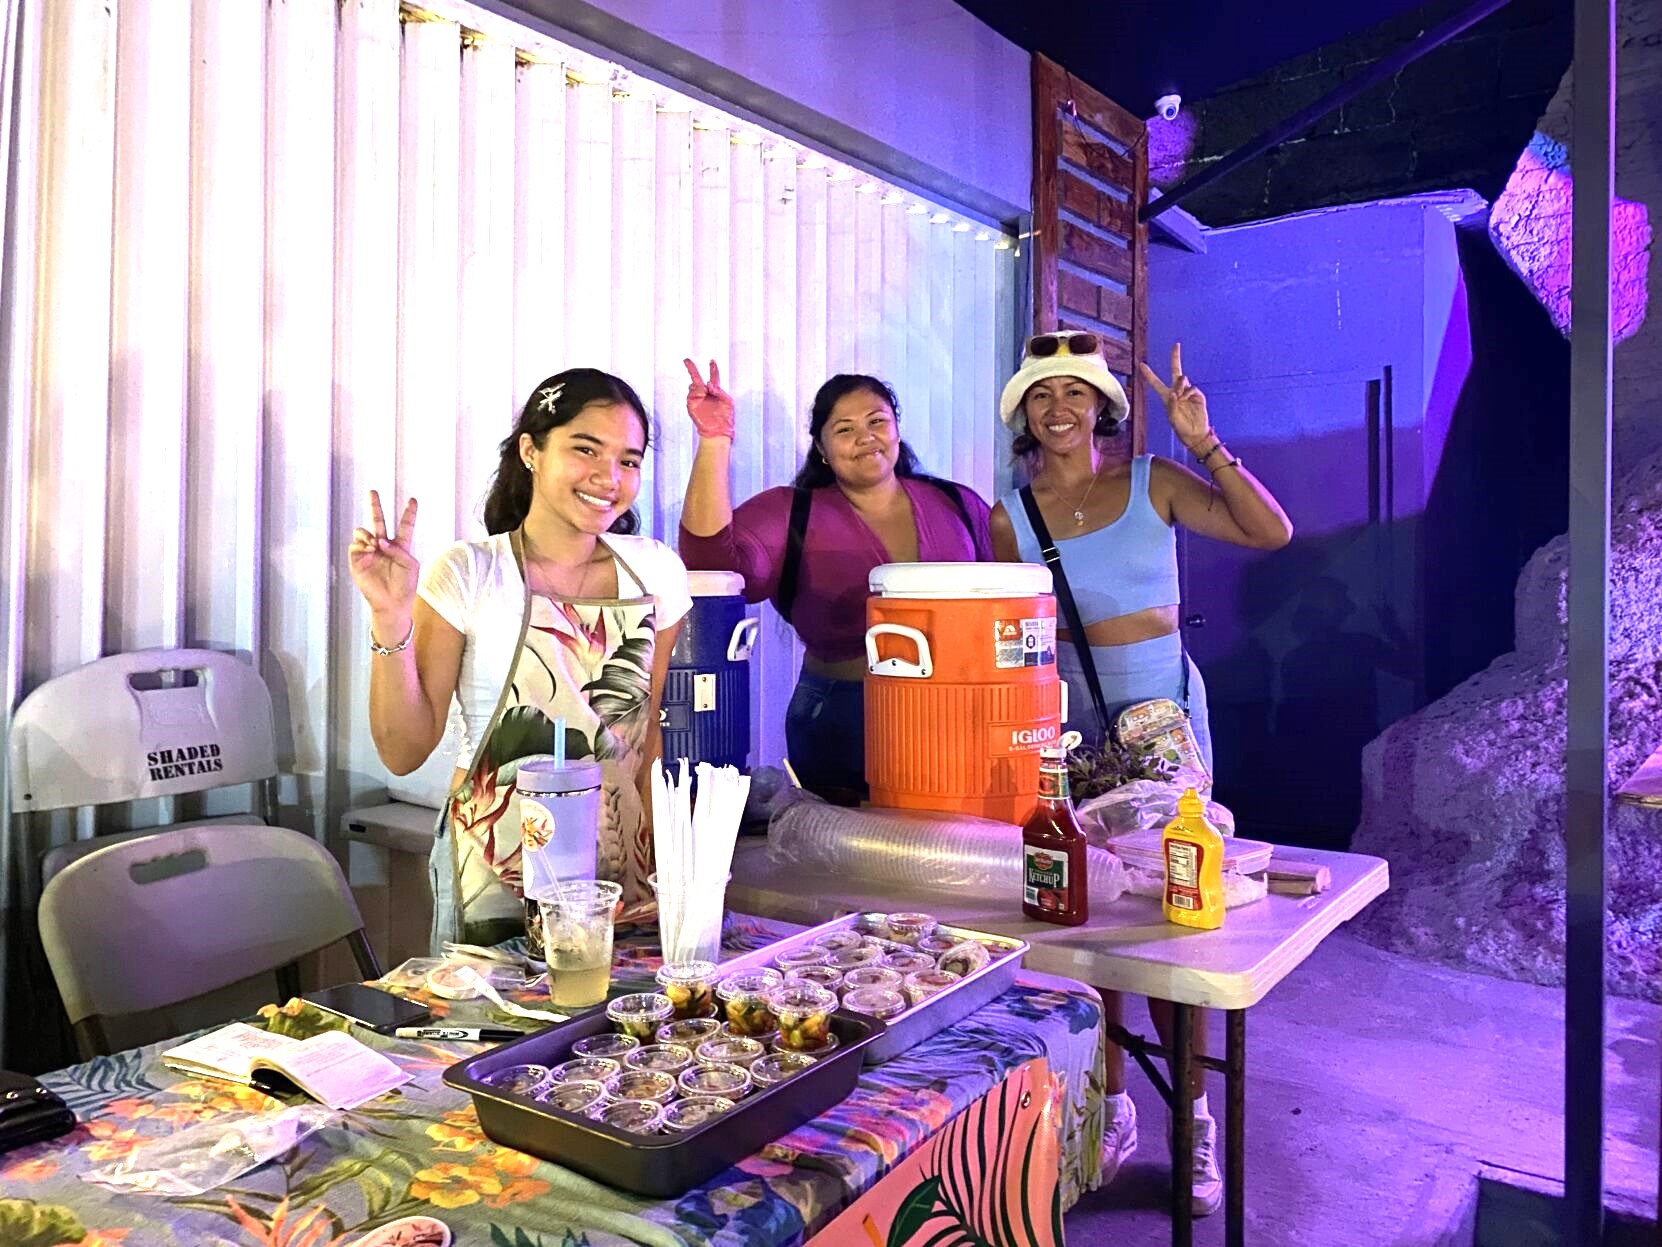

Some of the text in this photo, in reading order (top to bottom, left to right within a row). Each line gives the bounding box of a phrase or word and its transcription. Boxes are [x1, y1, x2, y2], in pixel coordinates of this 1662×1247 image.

[1012, 726, 1055, 745] IGLOO
[147, 744, 220, 766] SHADED
[149, 758, 223, 781] RENTALS
